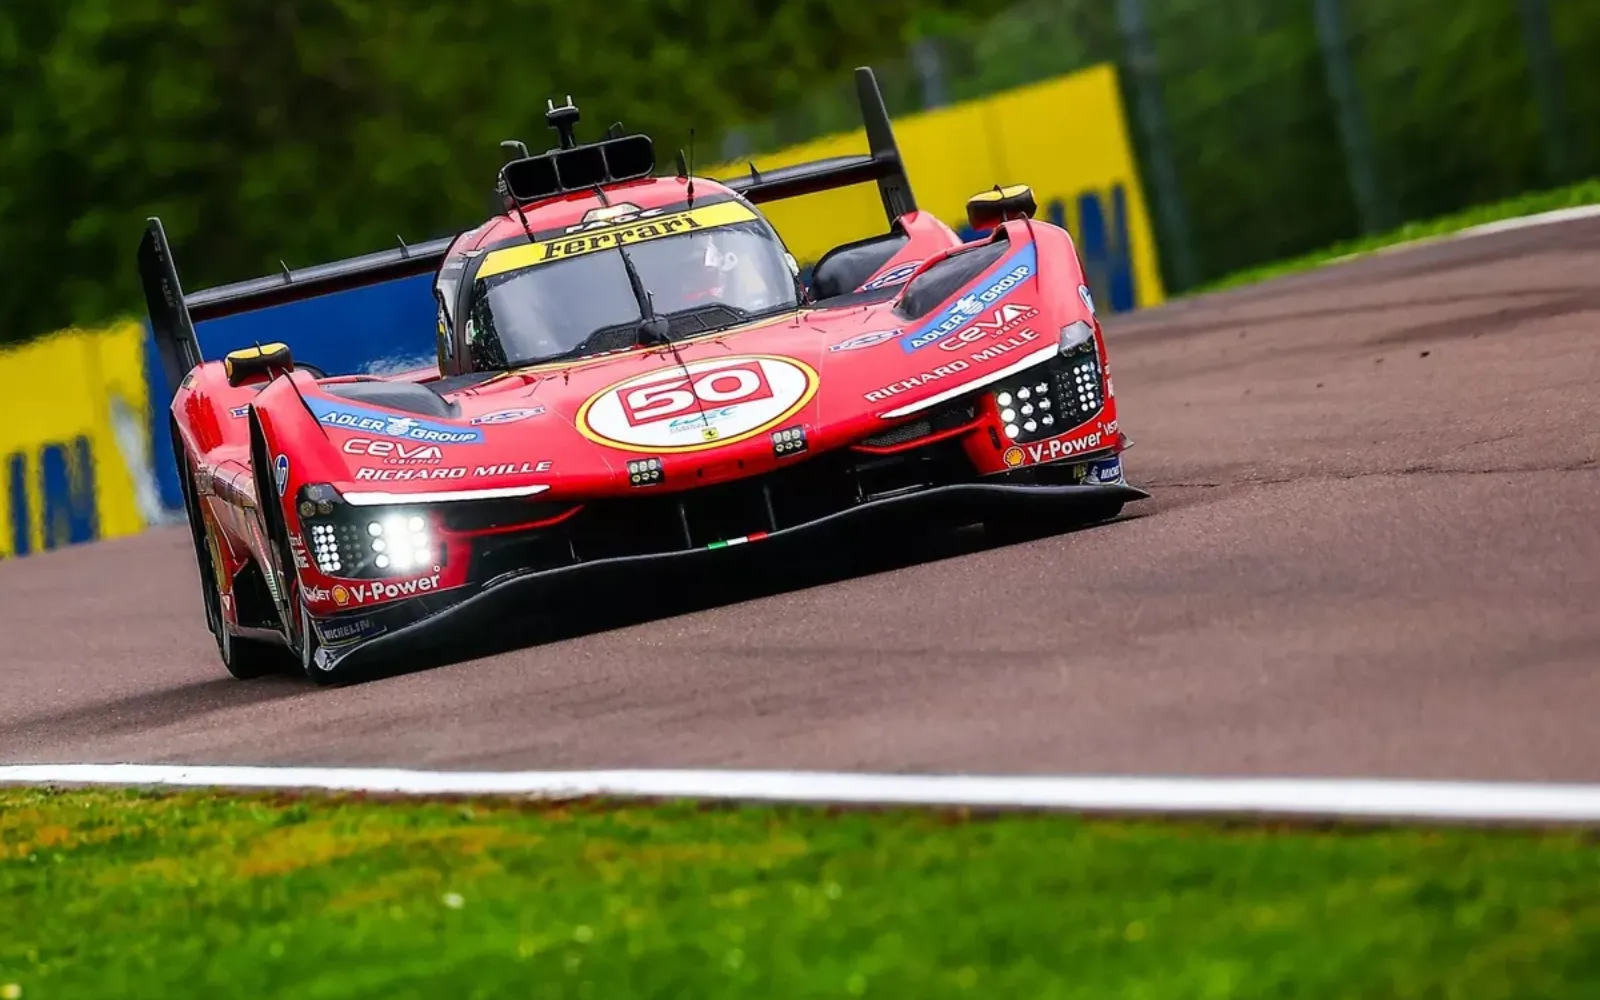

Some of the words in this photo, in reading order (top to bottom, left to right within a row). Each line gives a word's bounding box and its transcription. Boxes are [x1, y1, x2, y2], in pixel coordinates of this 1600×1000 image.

[544, 212, 702, 260] Ferrari
[911, 314, 966, 348] ADLER
[980, 265, 1029, 302] GROUP
[864, 360, 969, 403] RICHARD
[971, 328, 1040, 363] MILLE
[626, 368, 761, 421] 50
[320, 412, 385, 432] ADLER
[410, 428, 478, 442] GROUP
[1028, 431, 1102, 463] V-Power
[355, 467, 467, 481] RICHARD
[473, 461, 552, 477] MILLE
[350, 574, 440, 603] V-Power
[323, 619, 370, 640] MICHELIN
